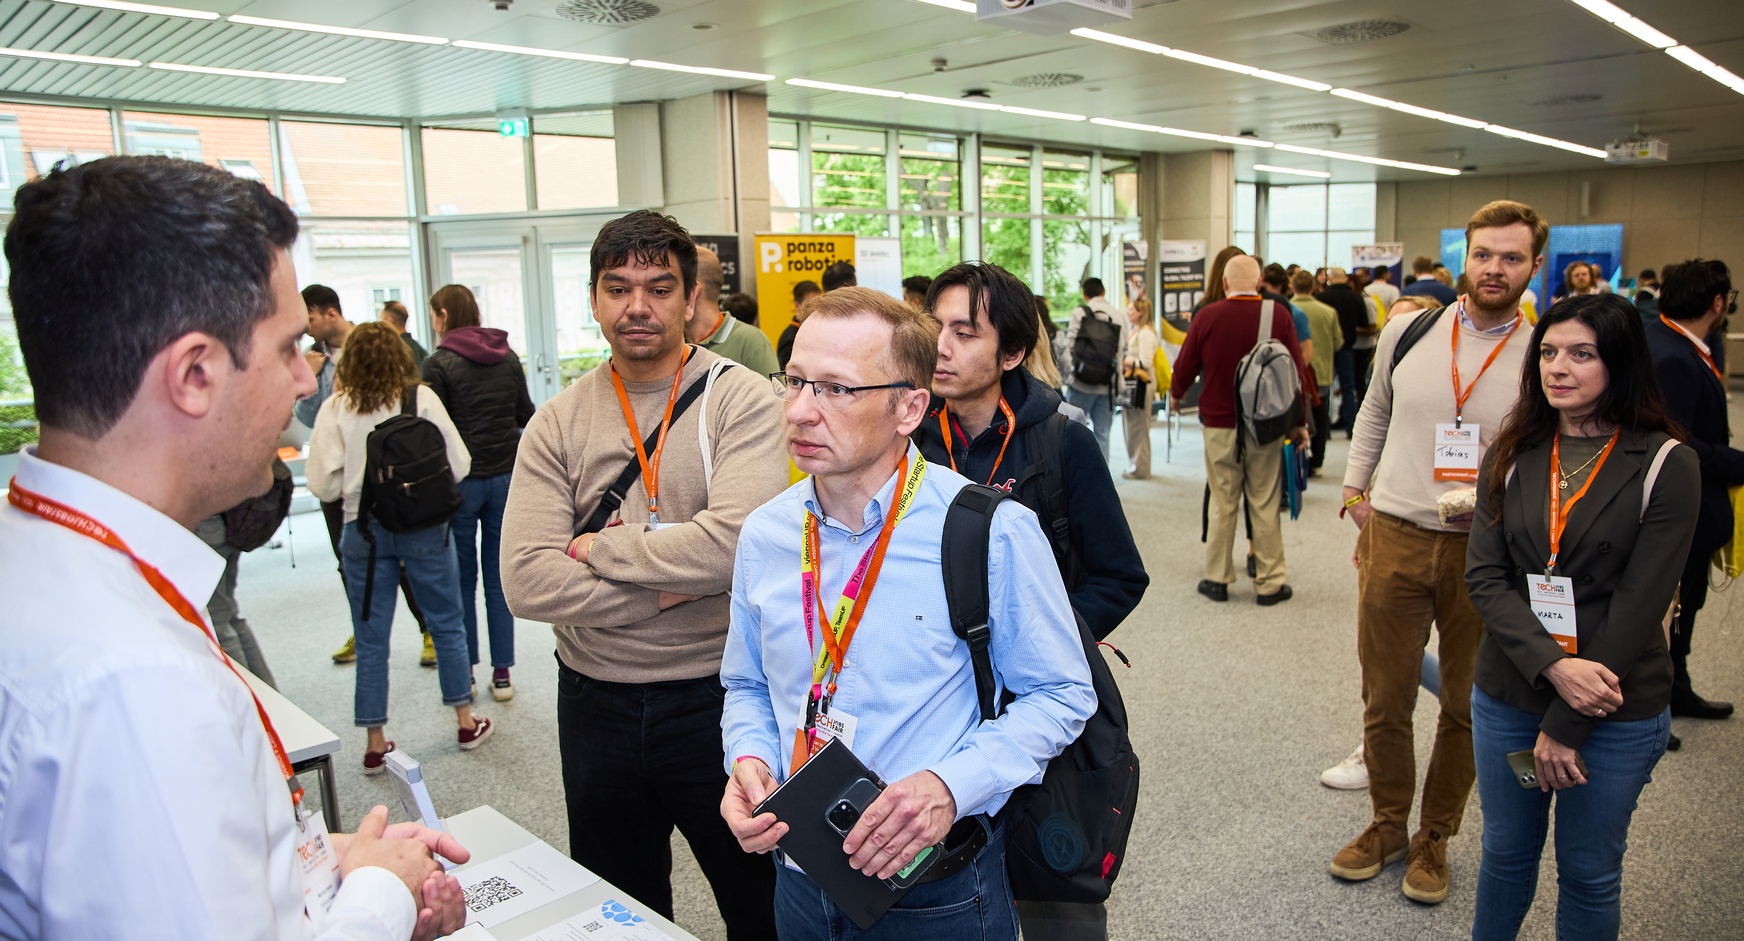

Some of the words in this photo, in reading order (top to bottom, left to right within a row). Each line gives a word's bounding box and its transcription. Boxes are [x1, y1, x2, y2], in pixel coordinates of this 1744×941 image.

[787, 241, 835, 257] panza
[1437, 445, 1468, 458] Tobias
[907, 460, 925, 491] Startup
[851, 567, 864, 584] The
[804, 579, 812, 614] Festival
[835, 605, 846, 626] TeamUP
[1537, 611, 1563, 620] MARTA
